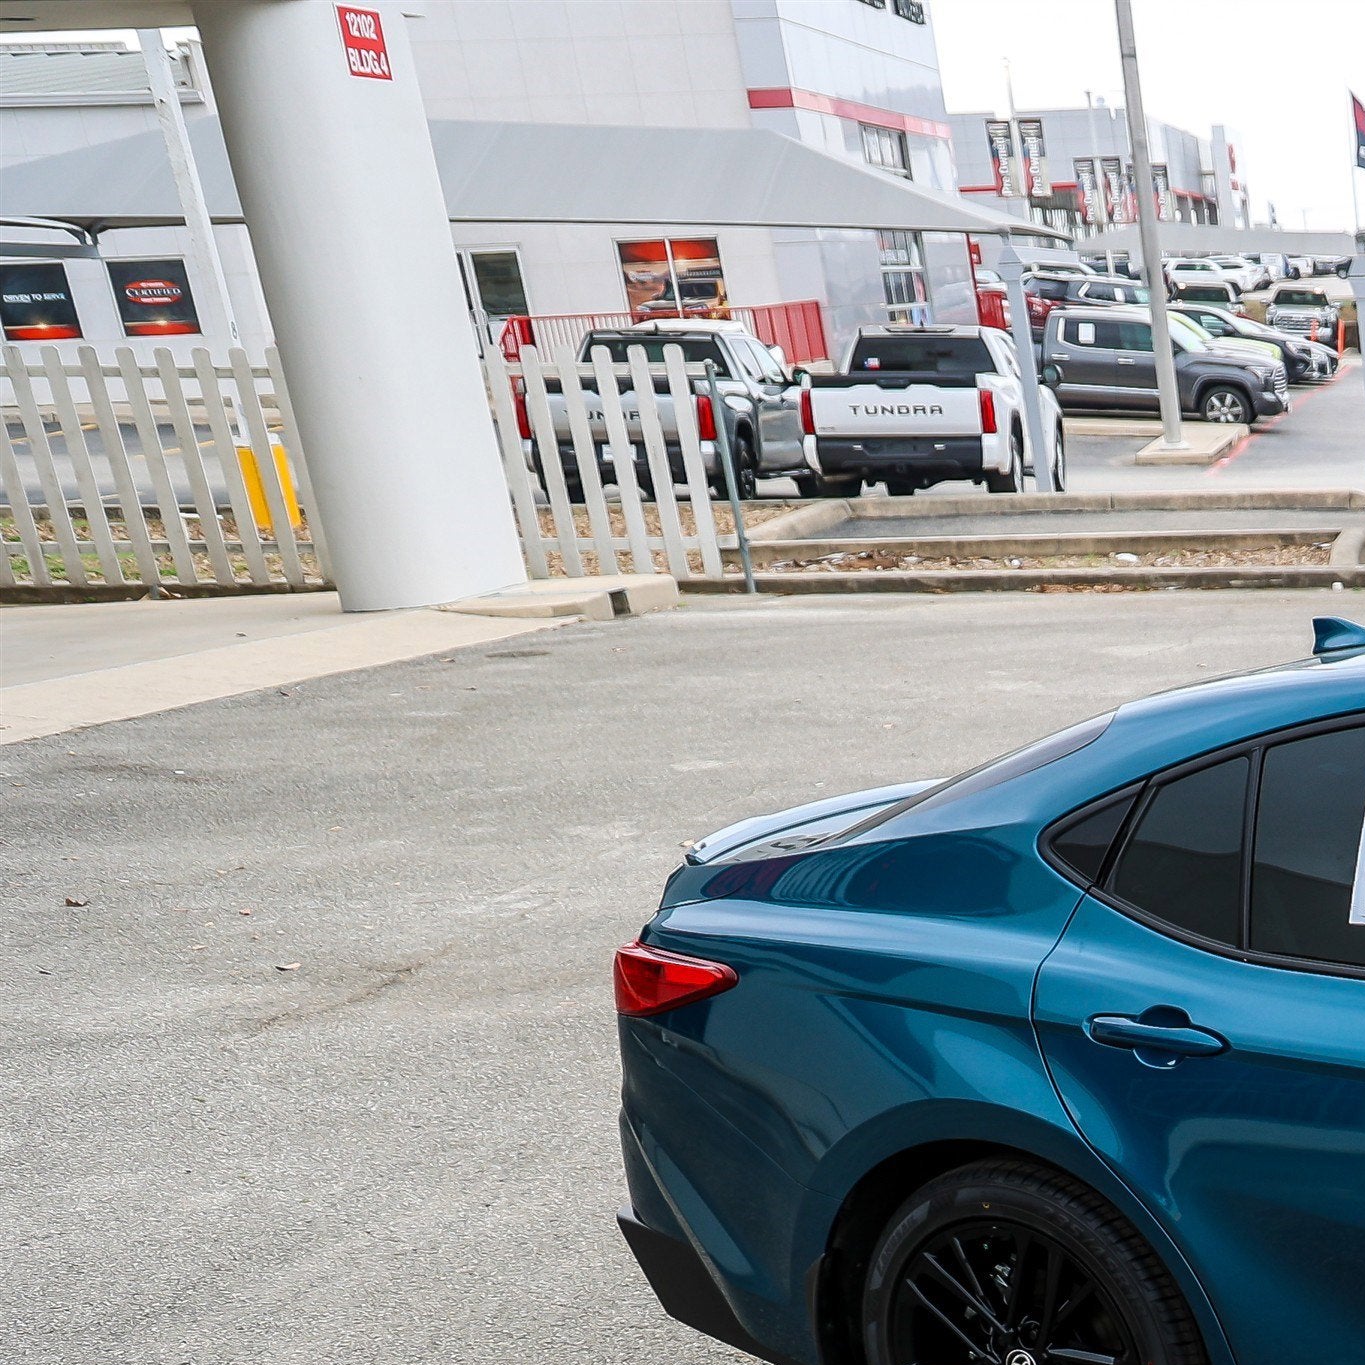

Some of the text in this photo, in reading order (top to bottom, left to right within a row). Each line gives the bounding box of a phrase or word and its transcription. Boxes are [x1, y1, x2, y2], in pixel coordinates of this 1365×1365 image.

[345, 12, 378, 39] 12102
[125, 288, 182, 298] CERTIFIED
[849, 405, 943, 416] TUNDRA
